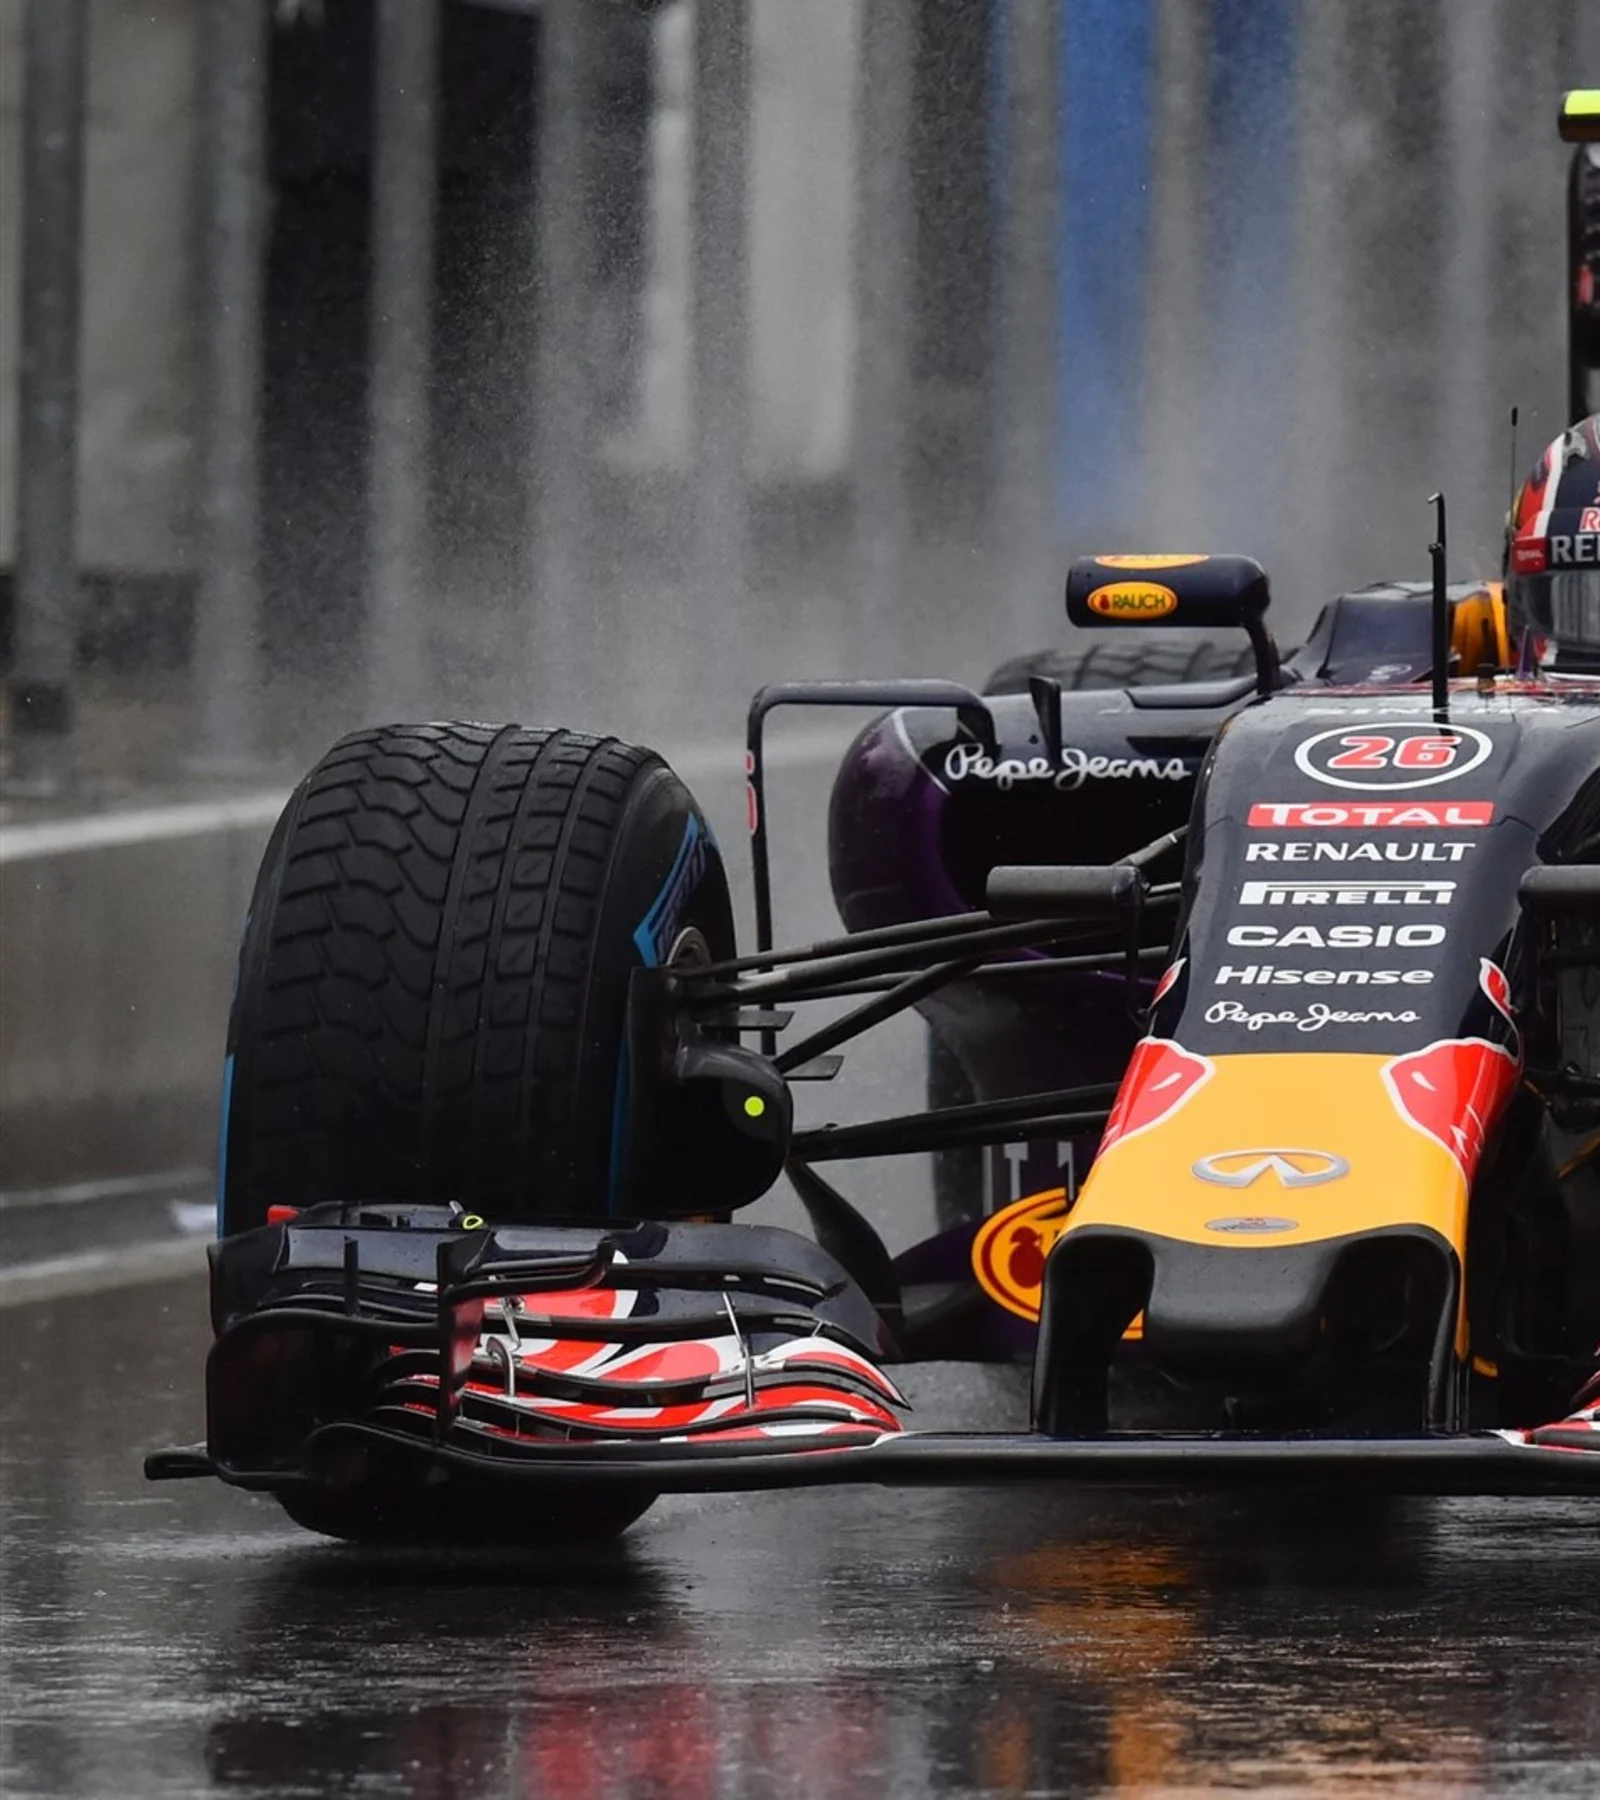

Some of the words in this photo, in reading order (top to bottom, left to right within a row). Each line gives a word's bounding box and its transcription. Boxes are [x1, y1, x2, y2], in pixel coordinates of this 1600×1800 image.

[1111, 594, 1166, 610] RAUCH
[1327, 735, 1462, 768] 26
[945, 743, 1054, 790] Pepe
[1055, 748, 1191, 790] Jeans
[1254, 803, 1484, 826] TOTAL
[1245, 842, 1477, 862] RENAULT
[1239, 881, 1457, 905] PIRELLI
[1226, 924, 1447, 948] CASIO
[1214, 965, 1435, 985] Hisense
[1204, 1001, 1299, 1031] Pepe
[1297, 1003, 1421, 1031] Jeans
